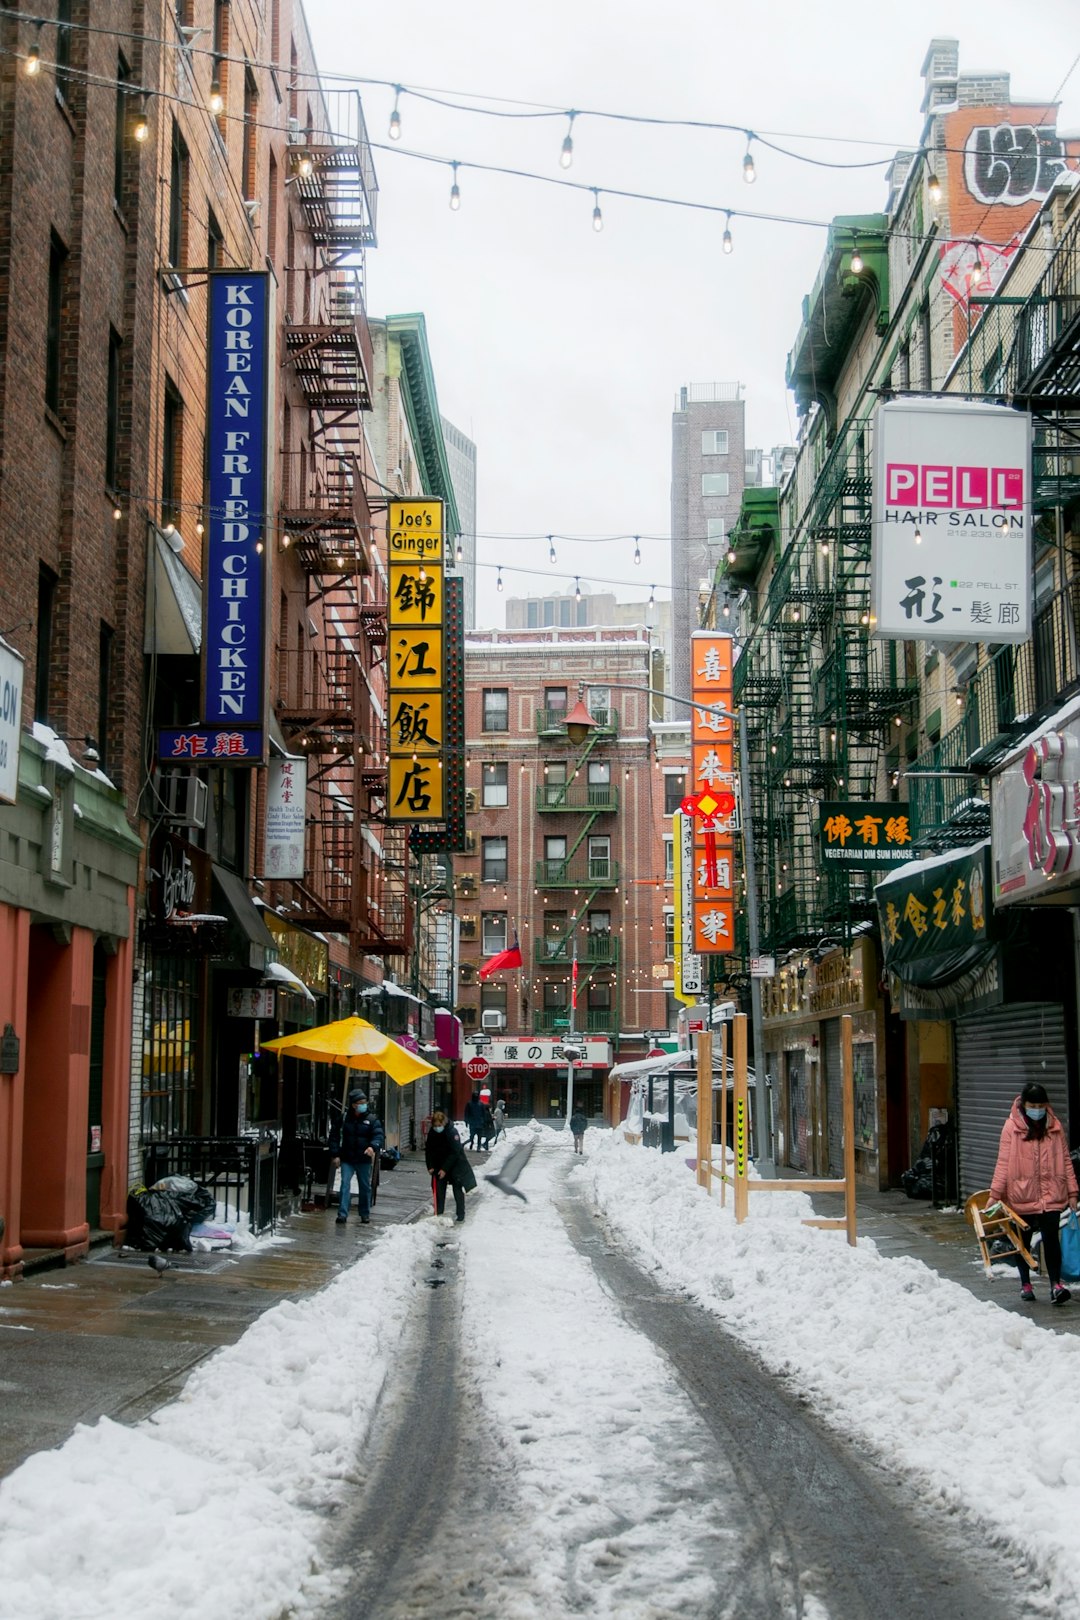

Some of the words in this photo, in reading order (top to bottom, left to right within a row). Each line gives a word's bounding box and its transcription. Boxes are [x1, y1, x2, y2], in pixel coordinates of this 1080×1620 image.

[224, 285, 254, 418] KOREAN
[221, 431, 251, 542] FRIED
[890, 469, 1017, 505] PELL
[399, 509, 432, 527] Joe's
[885, 510, 937, 525] HAIR
[949, 512, 1023, 528] SALON
[392, 532, 438, 555] Ginger
[218, 555, 249, 715] CHICKEN
[391, 573, 441, 813] 錦江飯店
[172, 733, 249, 757] 炸雞
[280, 763, 295, 804] 健康堂
[823, 814, 912, 847] 佛有緣
[824, 848, 863, 859] VEGETARIAN
[864, 849, 876, 859] DIM
[877, 849, 890, 859] SUM
[892, 849, 913, 859] HOUSE
[468, 1063, 489, 1073] STOP
